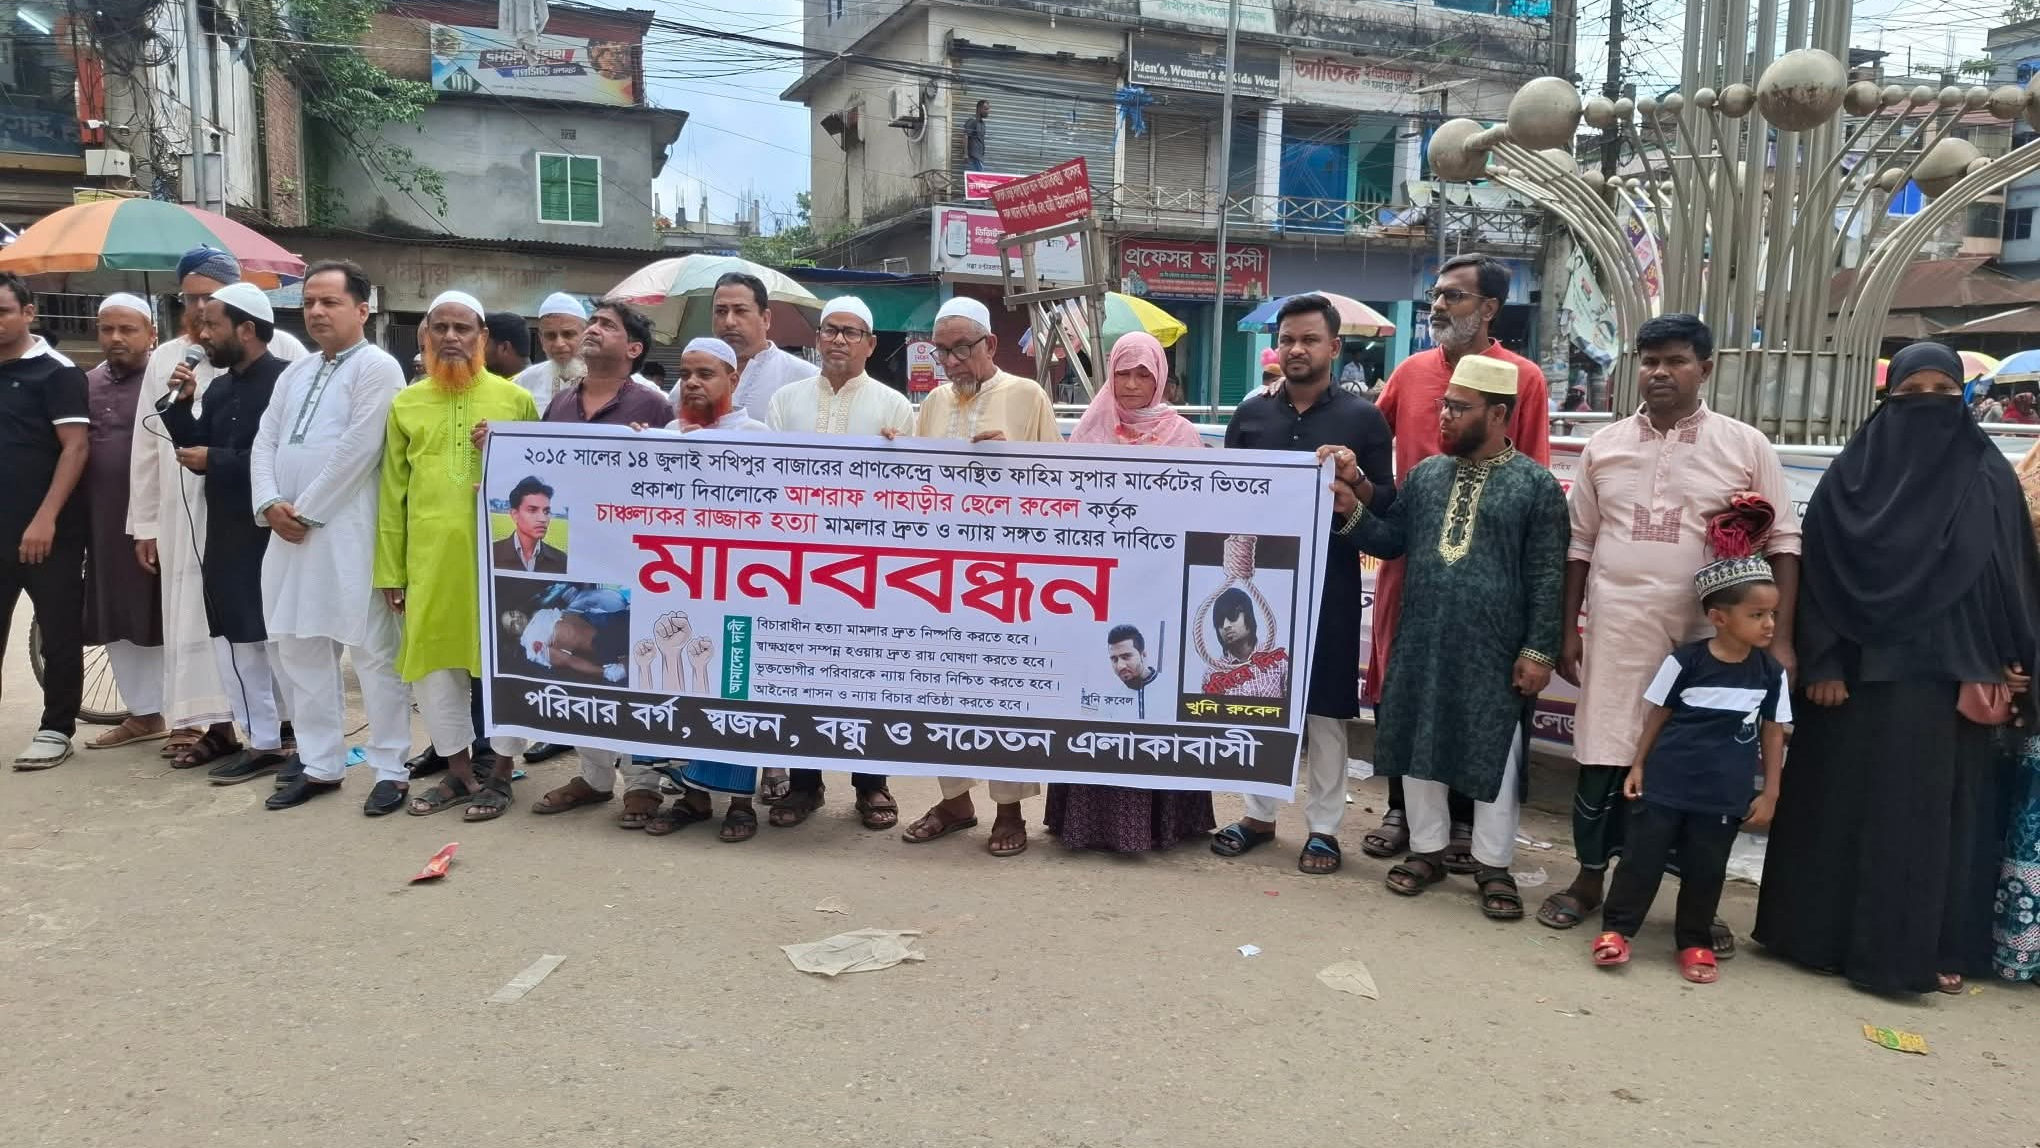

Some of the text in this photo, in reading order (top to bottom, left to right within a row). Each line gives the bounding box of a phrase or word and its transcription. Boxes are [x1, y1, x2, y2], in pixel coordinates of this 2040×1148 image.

[1170, 64, 1216, 80] Women's
[1254, 75, 1280, 88] Wear
[1125, 247, 1193, 270] প্রফেসর
[525, 448, 1273, 496] ২০১৫ সালের ১৪ জুলাই সখিপুর বাজারের প্রাণকেন্দ্রে অবস্থিত ফাহিম সুপার মার্কেটের ভিতরে
[631, 478, 1138, 528] প্রকাশ্য দিবালোকে আশরাফ পাহাড়ীর ছেলে রুবেল কর্তৃক
[595, 502, 1177, 551] চাঞ্চল্যকর রাজ্জাক হত্যা মামলার দ্রুত ও ন্যায় সঙ্গত রায়ের দাবিতে
[631, 534, 1119, 623] মানববন্ধন
[756, 617, 810, 632] বিচারাধীন
[815, 622, 842, 635] হত্যা
[847, 624, 888, 637] মামলার
[892, 626, 918, 639] দ্রুত
[967, 632, 1002, 645] করতে
[727, 618, 745, 695] আমাদের দাবী
[808, 644, 841, 657] সম্পন্ন
[845, 646, 883, 659] হওয়ায়
[886, 648, 911, 662] দ্রুত
[916, 649, 936, 662] রায়
[940, 651, 978, 665] ঘোষণা
[982, 654, 1018, 668] করতে
[819, 664, 876, 681] পরিবারকে
[880, 669, 906, 683] ন্যায়
[910, 668, 941, 684] বিচার
[946, 671, 985, 687] নিশ্চিত
[989, 676, 1025, 690] করতে
[753, 682, 798, 698] আইনের
[802, 686, 833, 699] শাসন
[838, 690, 848, 700] ও
[851, 689, 877, 702] ন্যায়
[881, 689, 912, 704] বিচার
[916, 691, 954, 707] প্রতিষ্ঠা
[958, 696, 994, 709] করতে
[1103, 695, 1134, 706] রুবেল
[1185, 699, 1283, 718] খুনি রুবেল
[524, 686, 621, 726] পরিবার
[700, 708, 800, 748] স্বজন,
[811, 716, 872, 756] বন্ধু
[883, 722, 912, 746] ও
[923, 722, 1057, 758] সচেতন
[1067, 728, 1264, 768] এলাকাবাসী
